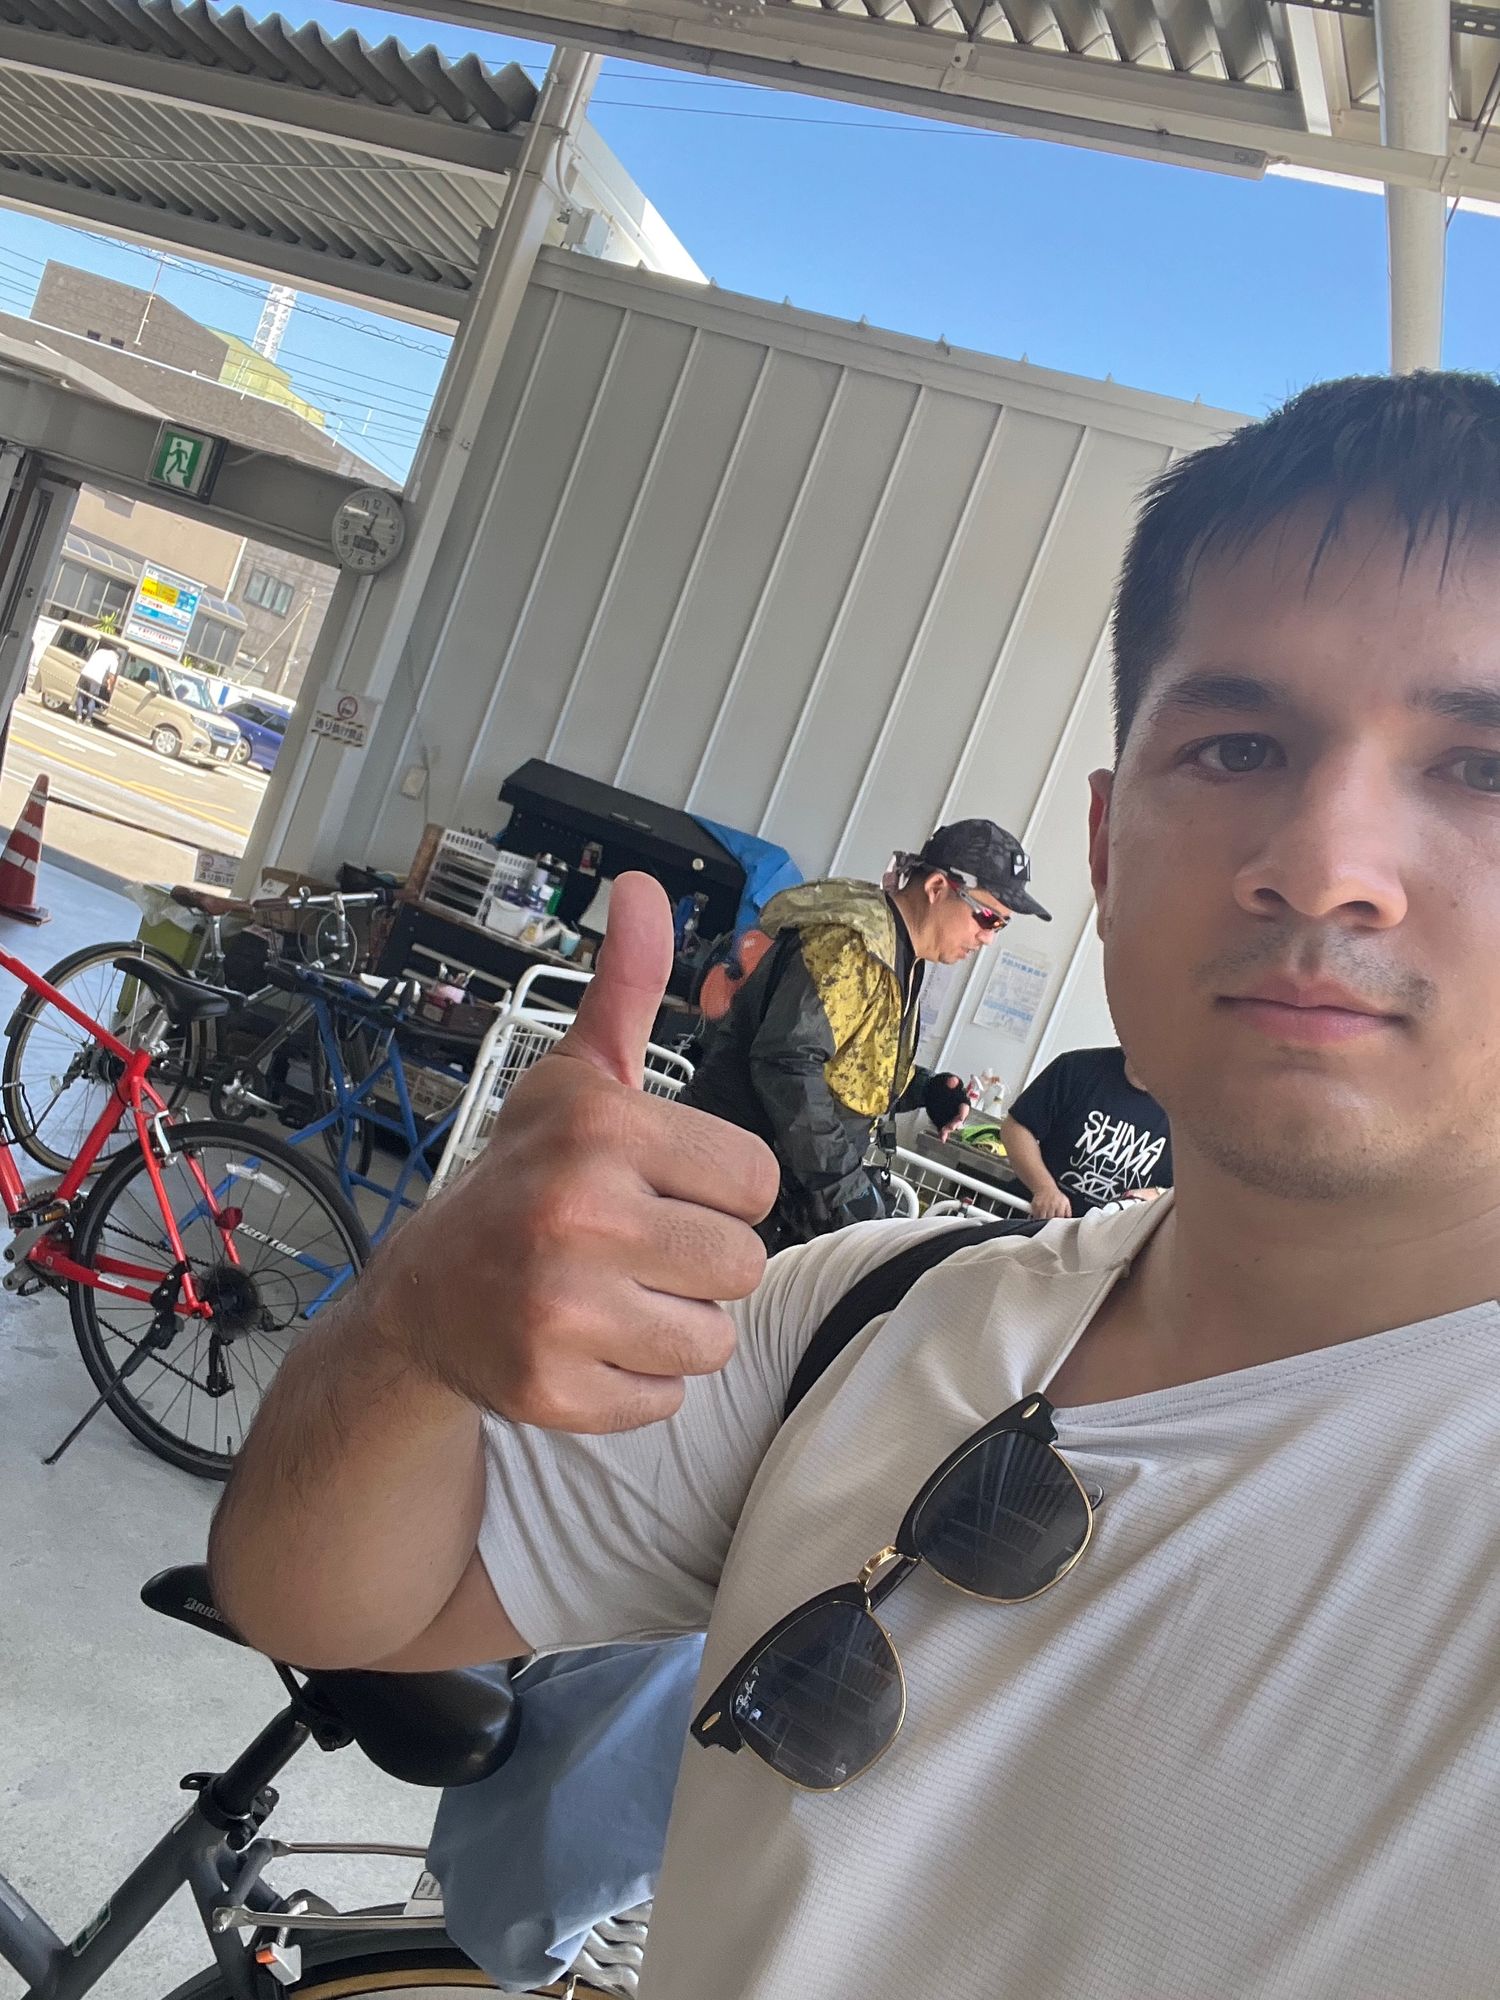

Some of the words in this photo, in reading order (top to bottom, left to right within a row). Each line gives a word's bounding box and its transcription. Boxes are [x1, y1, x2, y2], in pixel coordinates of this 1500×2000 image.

[1074, 1131, 1158, 1177] NAMI
[1084, 1110, 1167, 1160] SHIMA
[1069, 1147, 1153, 1190] JAPAN
